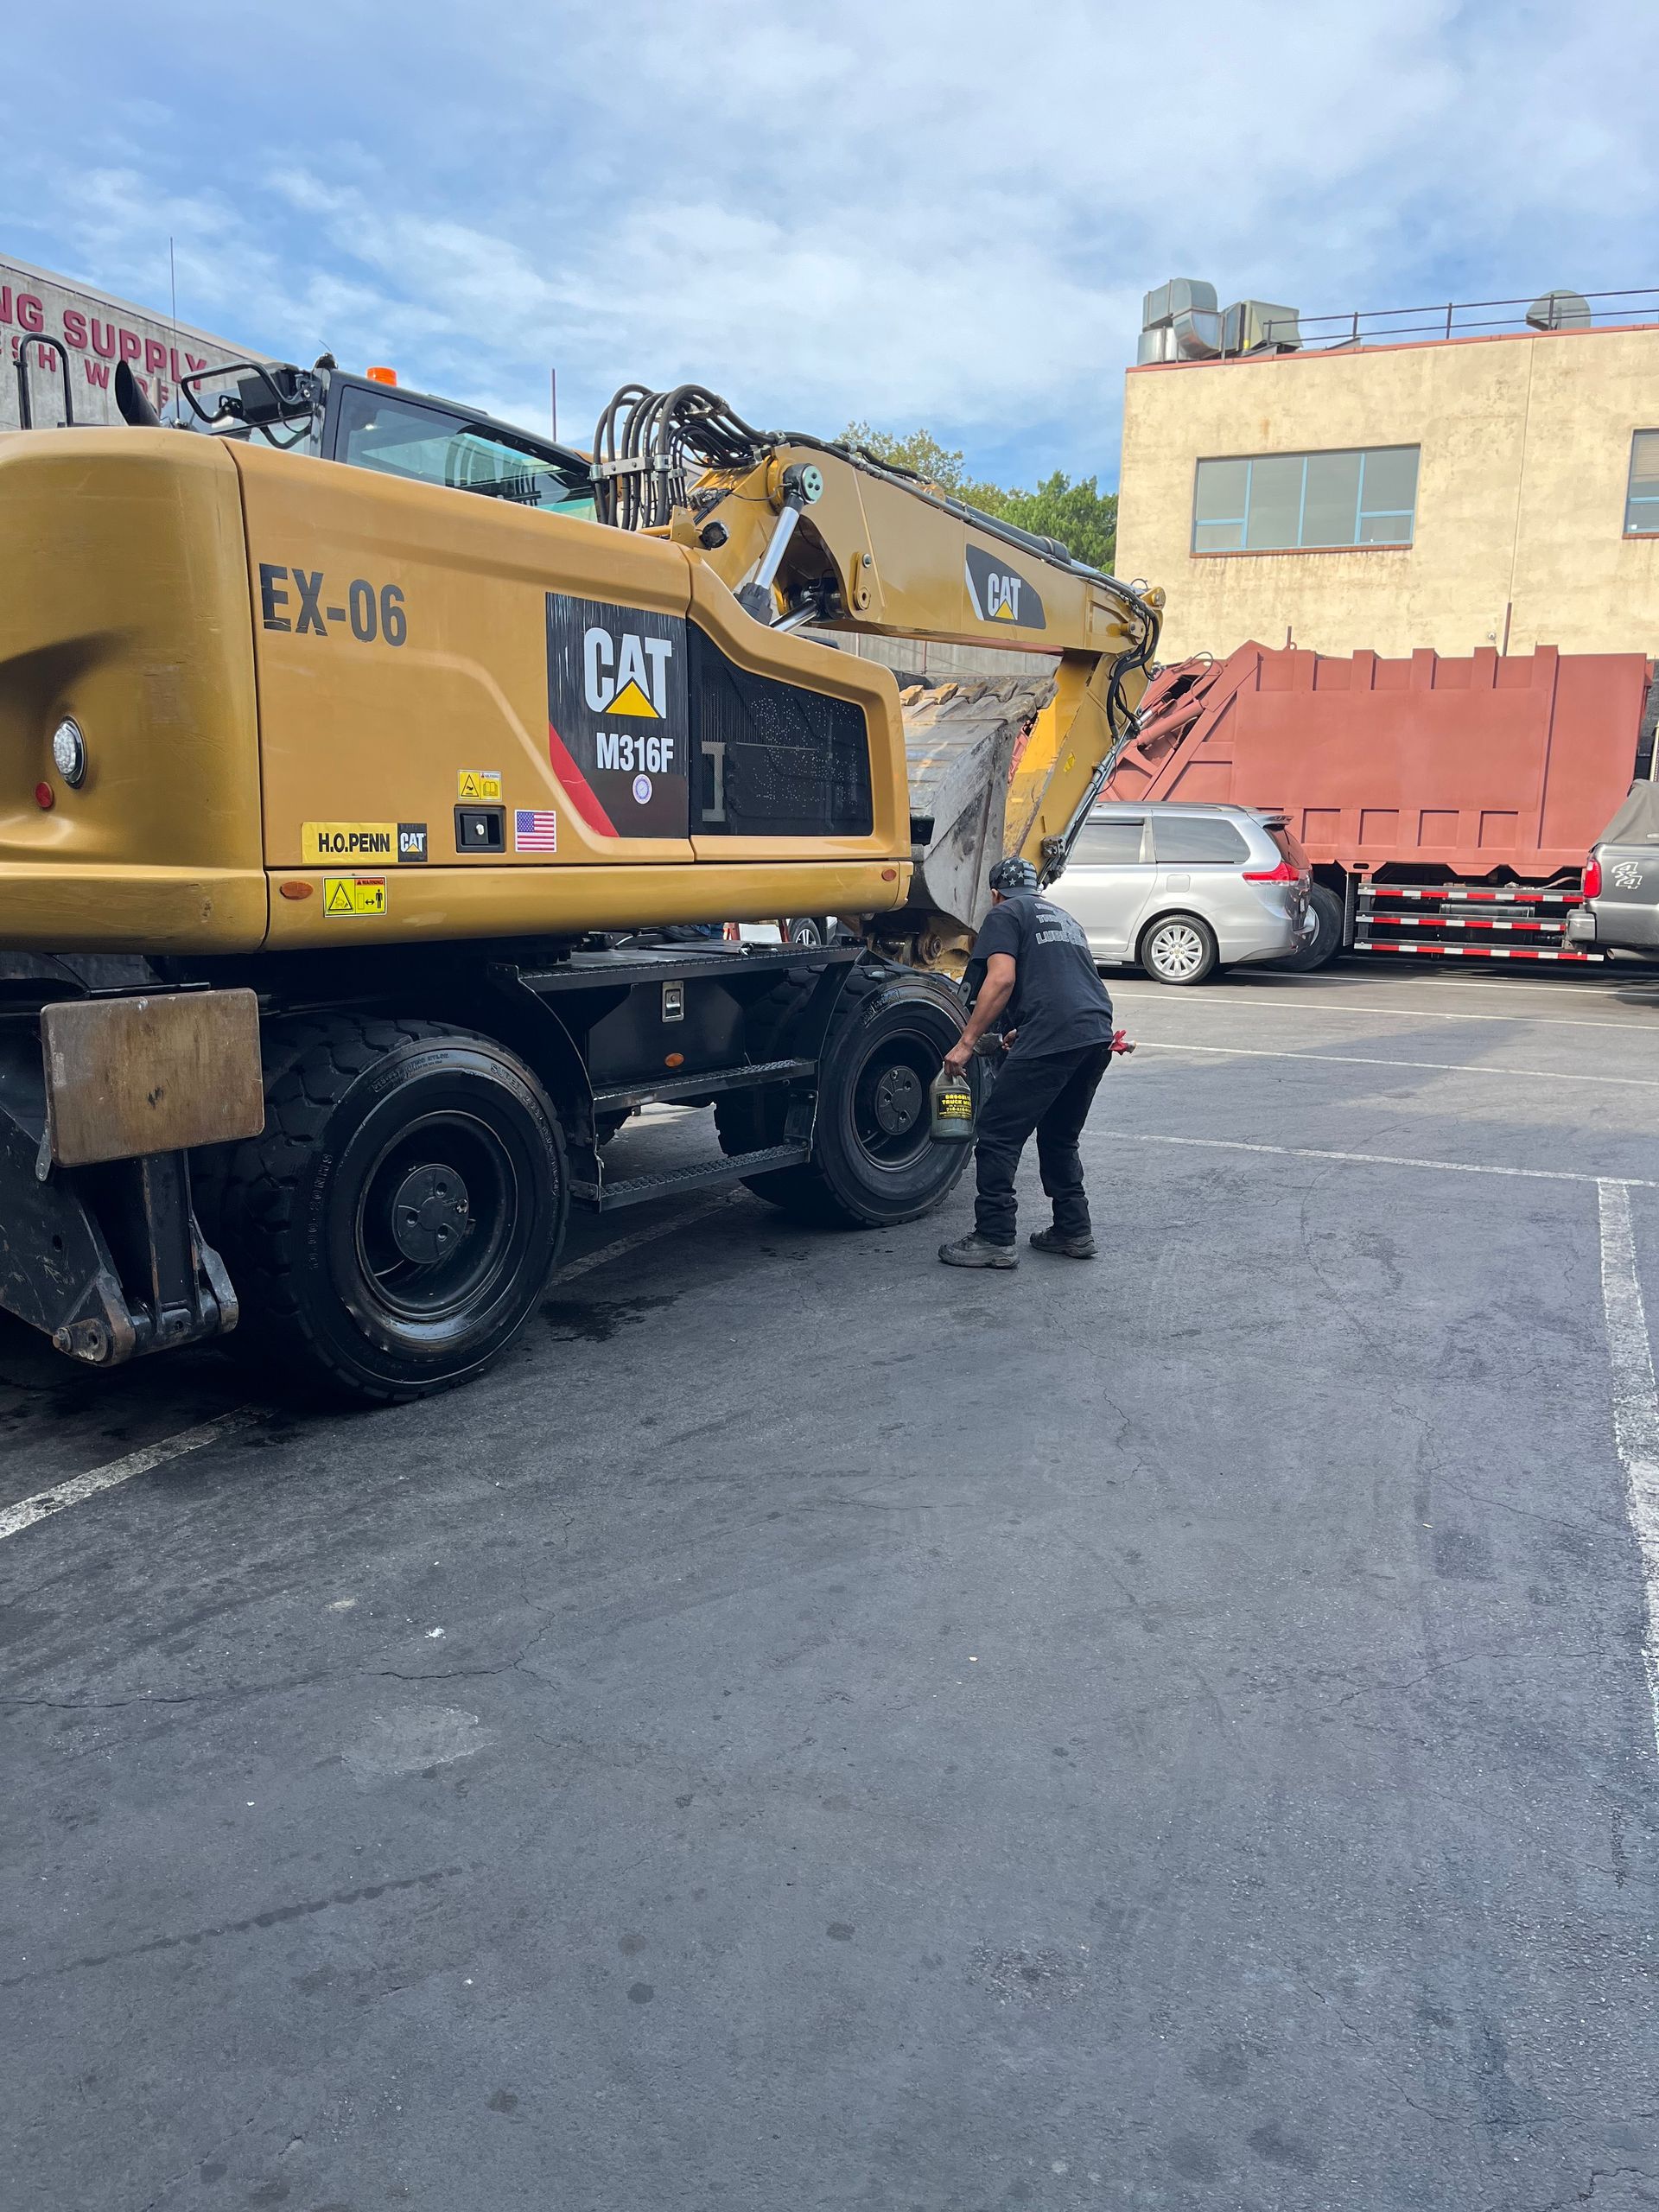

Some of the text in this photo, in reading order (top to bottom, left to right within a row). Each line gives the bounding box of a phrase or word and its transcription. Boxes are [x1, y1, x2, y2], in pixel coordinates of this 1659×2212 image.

[63, 309, 207, 390] SUPPLY
[258, 563, 407, 646] EX-06
[988, 572, 1021, 620] CAT
[583, 626, 672, 719] CAT
[596, 732, 674, 773] M316F
[318, 832, 426, 853] H.O.PENN CAT
